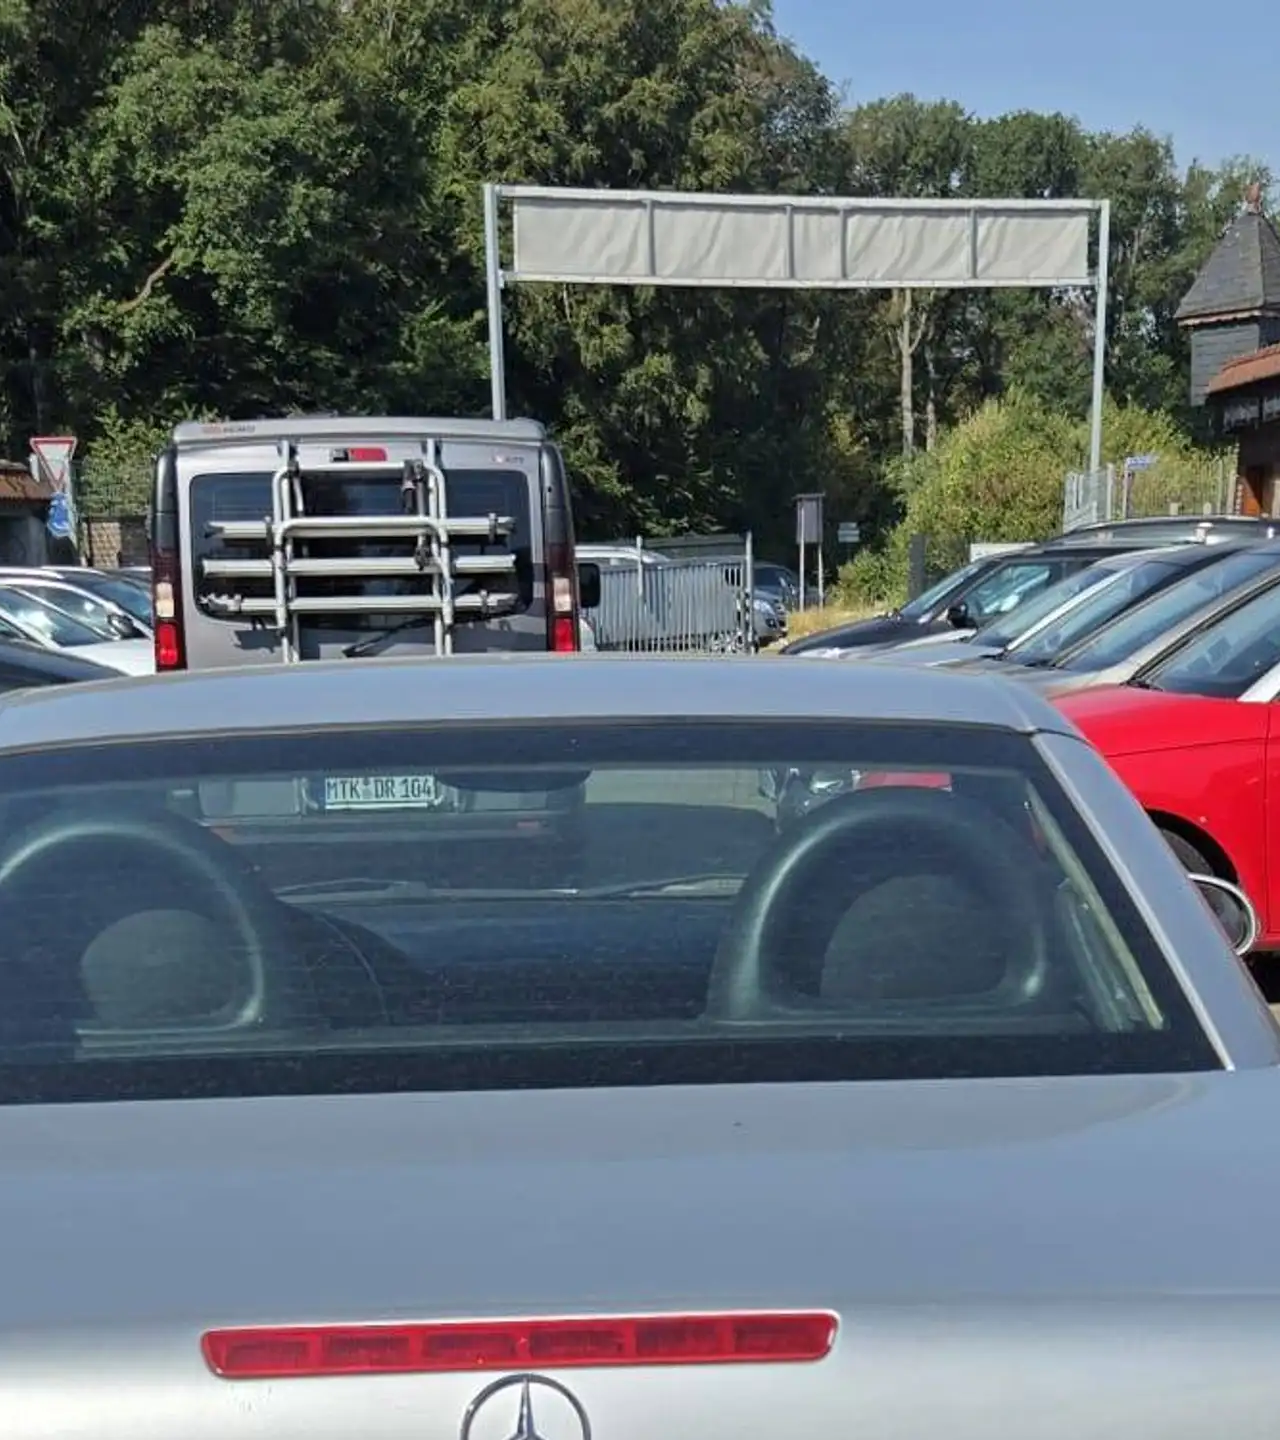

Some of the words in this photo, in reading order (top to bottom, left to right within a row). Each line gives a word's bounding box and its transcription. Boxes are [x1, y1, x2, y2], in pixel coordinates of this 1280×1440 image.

[326, 779, 361, 800] MTK
[374, 778, 396, 800] DR
[400, 777, 432, 799] 104
